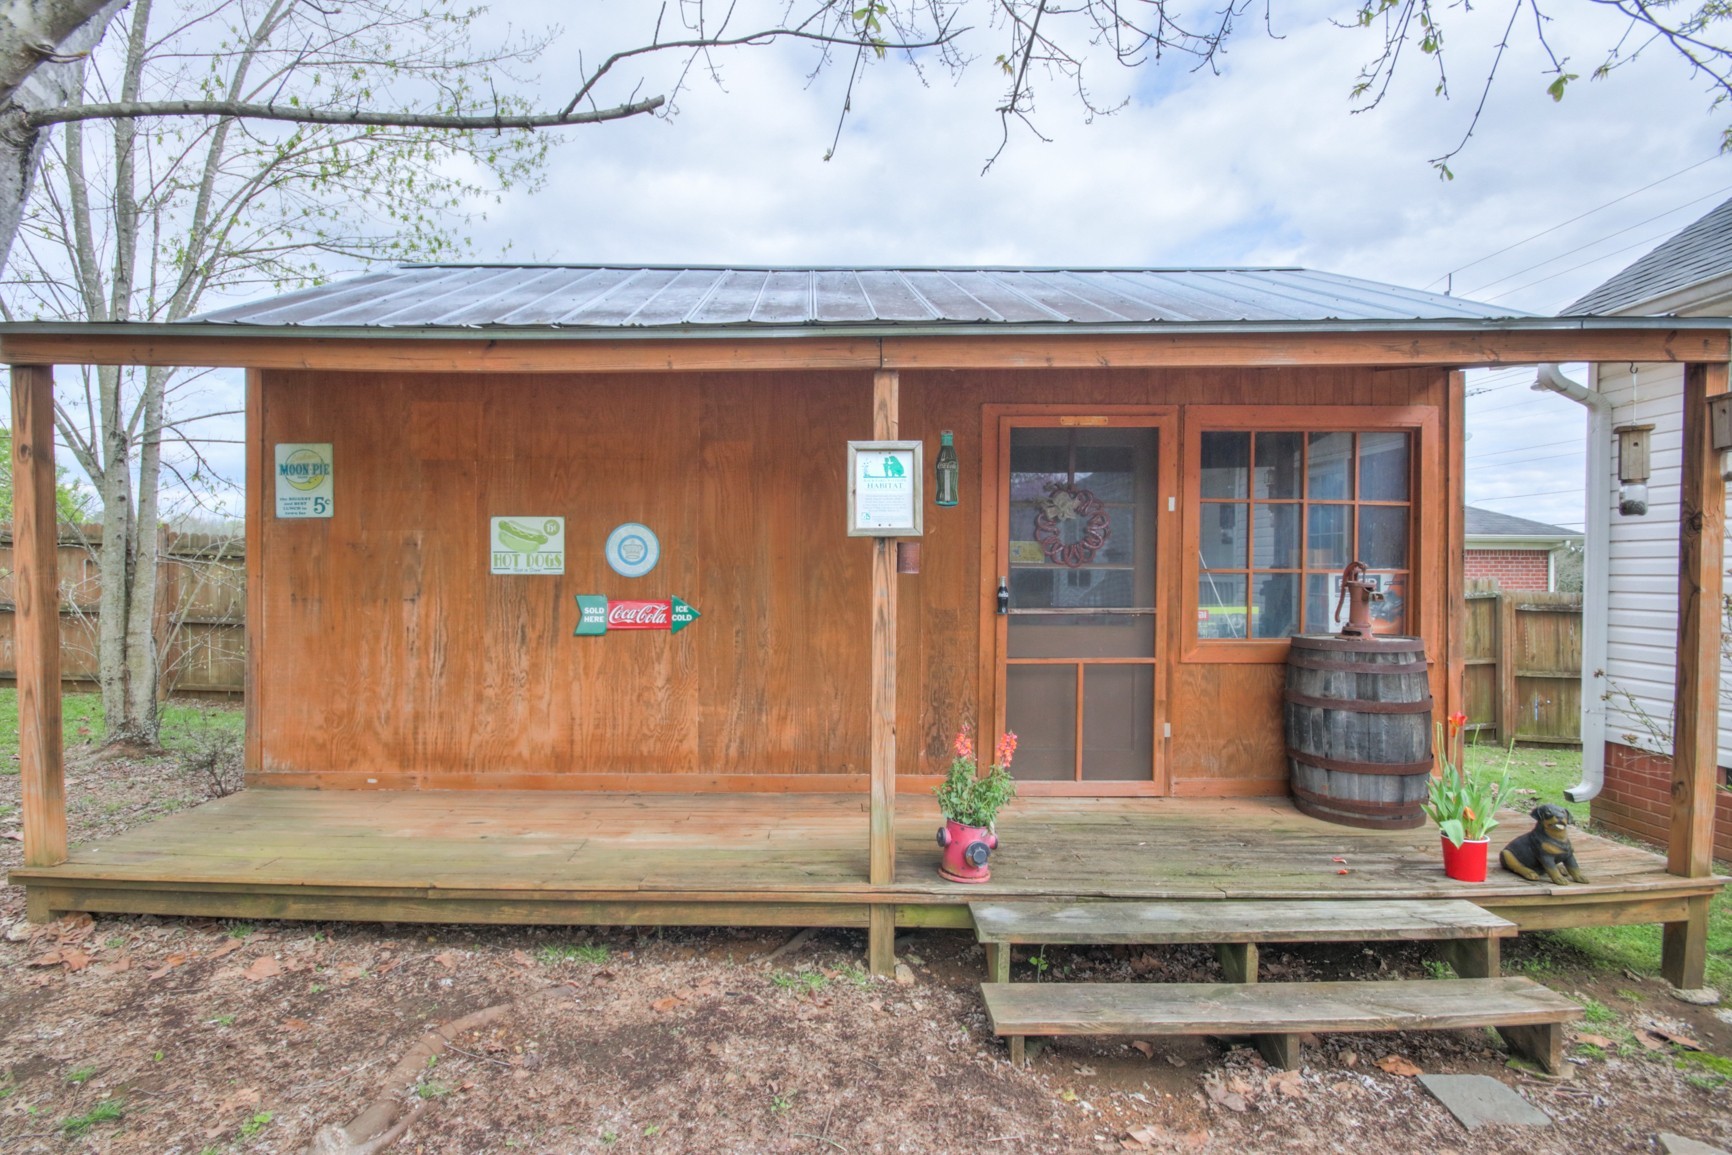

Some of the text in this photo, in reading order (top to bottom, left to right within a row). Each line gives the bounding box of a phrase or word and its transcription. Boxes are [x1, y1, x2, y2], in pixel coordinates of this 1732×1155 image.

[279, 463, 330, 475] MOON PIE
[493, 553, 562, 568] HOT DOGS
